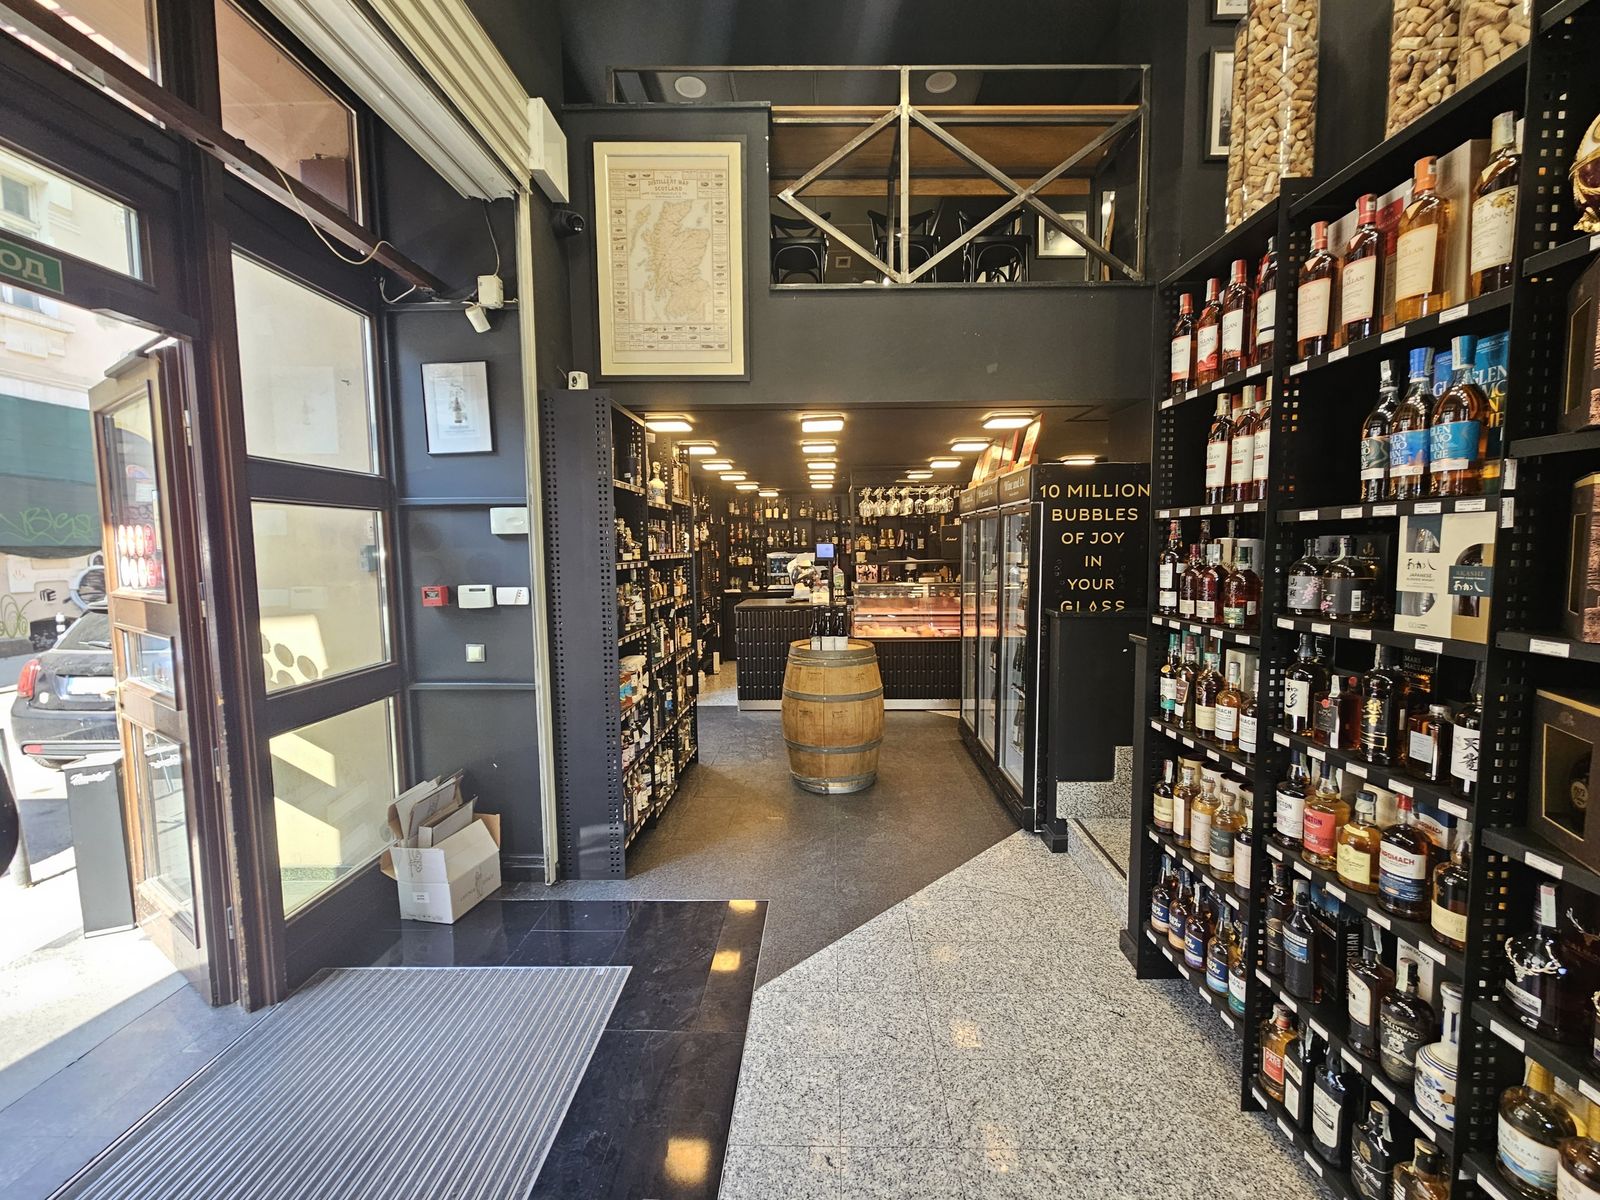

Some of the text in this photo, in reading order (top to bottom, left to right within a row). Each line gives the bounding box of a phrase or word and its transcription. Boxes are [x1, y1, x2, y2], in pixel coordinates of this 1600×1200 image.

[0, 249, 47, 285] ОД
[1433, 380, 1448, 397] GL
[1040, 483, 1150, 498] 10 MILLION
[1052, 508, 1138, 521] BUBBLES
[1061, 532, 1125, 544] OF JOY
[1085, 555, 1102, 567] IN
[1067, 578, 1115, 590] YOUR
